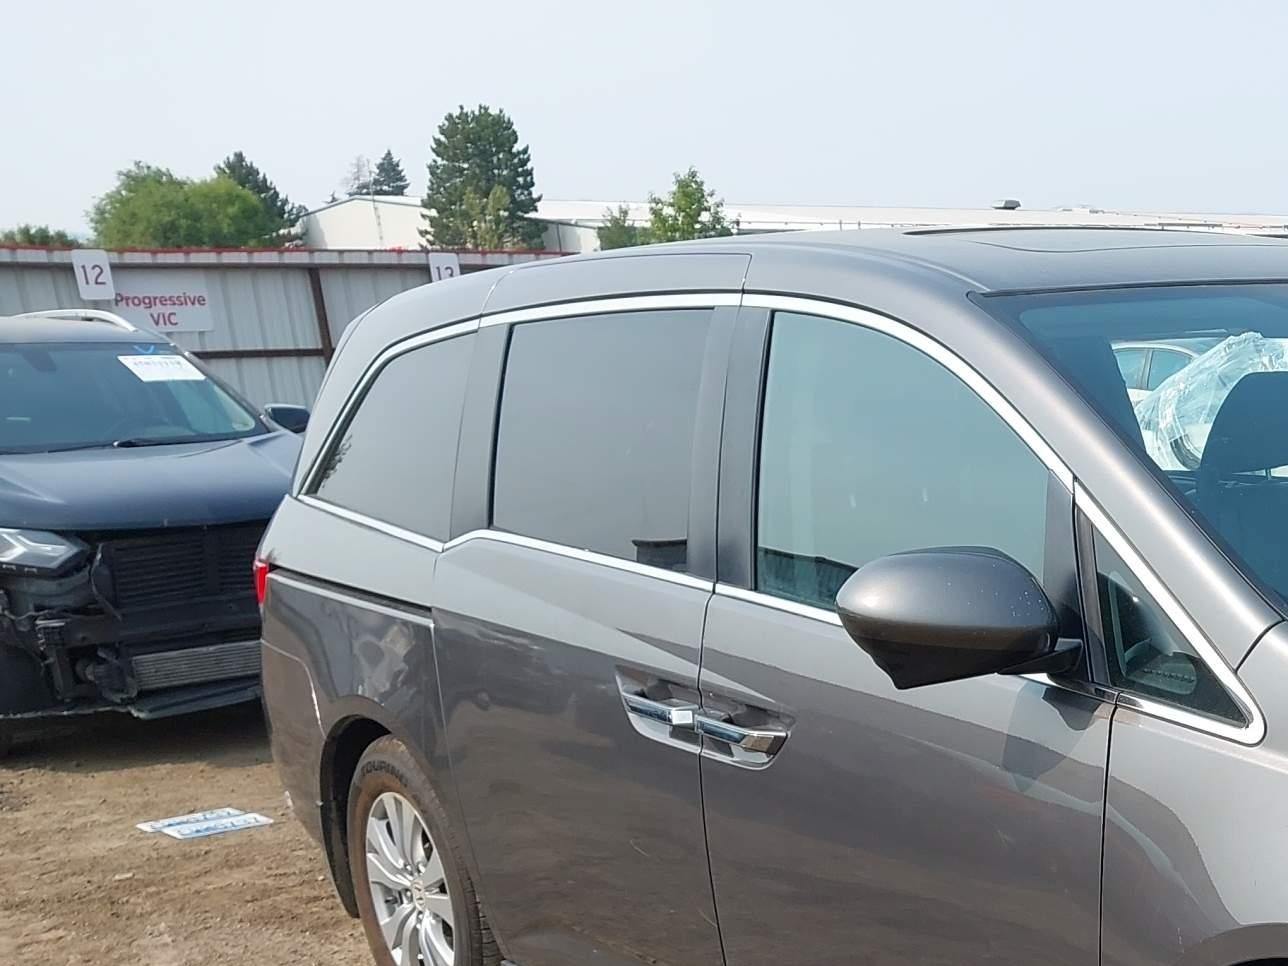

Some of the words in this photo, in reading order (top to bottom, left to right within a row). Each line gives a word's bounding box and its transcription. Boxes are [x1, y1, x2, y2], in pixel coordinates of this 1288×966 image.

[81, 264, 107, 286] 12
[115, 292, 206, 309] Progressive
[150, 312, 178, 326] VIC
